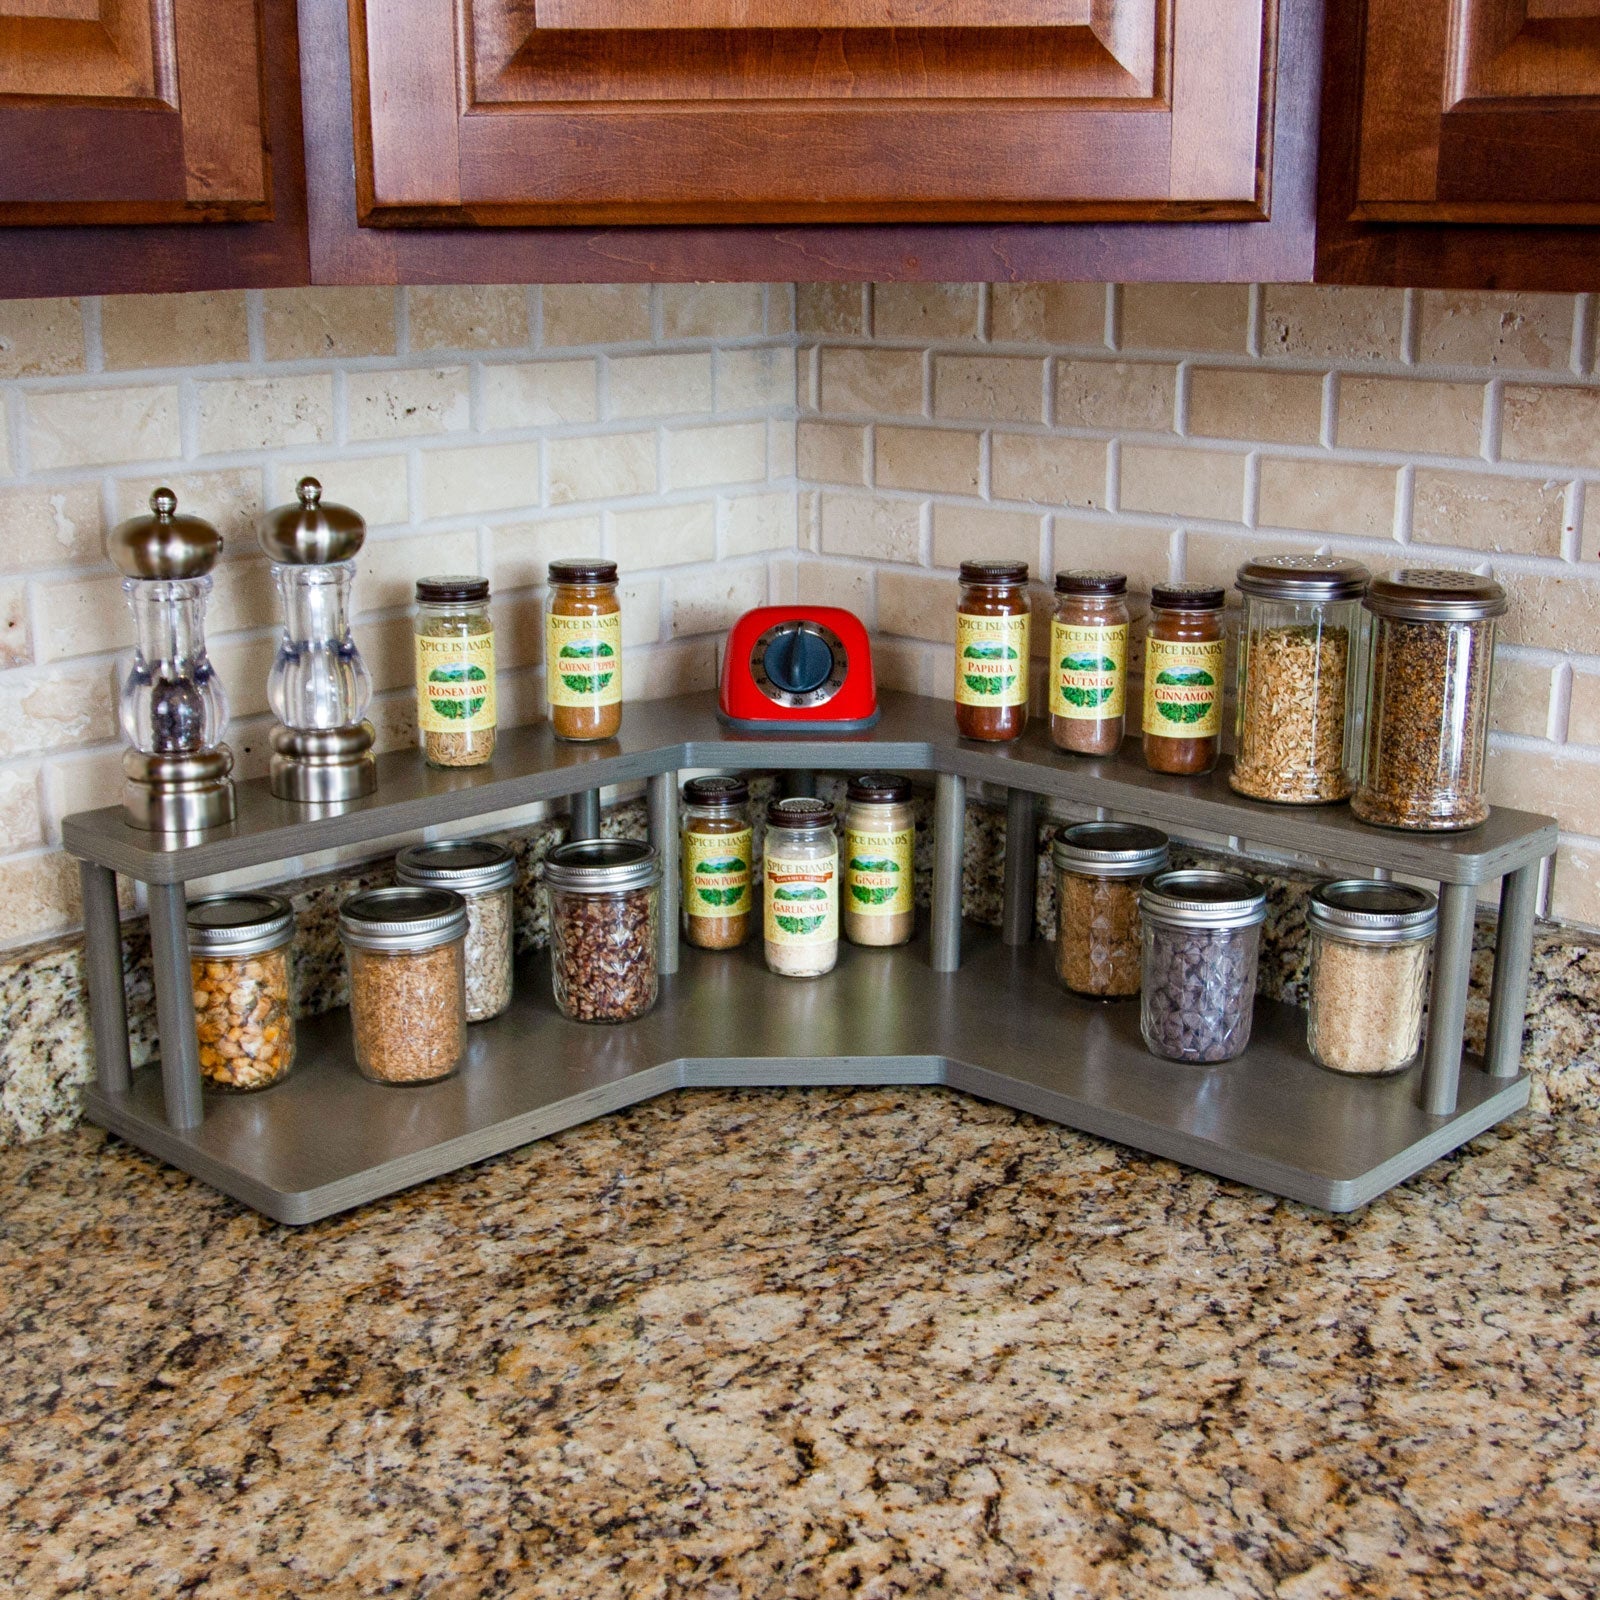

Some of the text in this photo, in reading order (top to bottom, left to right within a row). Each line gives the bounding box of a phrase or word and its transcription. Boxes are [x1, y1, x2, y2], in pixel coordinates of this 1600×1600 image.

[551, 617, 579, 629] SPICE
[958, 617, 983, 630] SPICE
[1055, 627, 1081, 640] SPICE
[420, 637, 492, 652] SPICE ISANDS
[1150, 641, 1222, 655] SPICE ISLANDS
[558, 660, 591, 672] CAYENNE
[1062, 673, 1114, 686] NUTMEG
[428, 684, 488, 697] ROSEMARY
[1154, 689, 1215, 702] CINNAMON
[688, 834, 715, 847] SPICE
[867, 834, 908, 846] ISLANDS
[767, 859, 834, 873] SPICE ISLANDS
[694, 876, 719, 886] ONION
[855, 874, 892, 886] GINGER
[773, 901, 830, 914] GARLIC SALT
